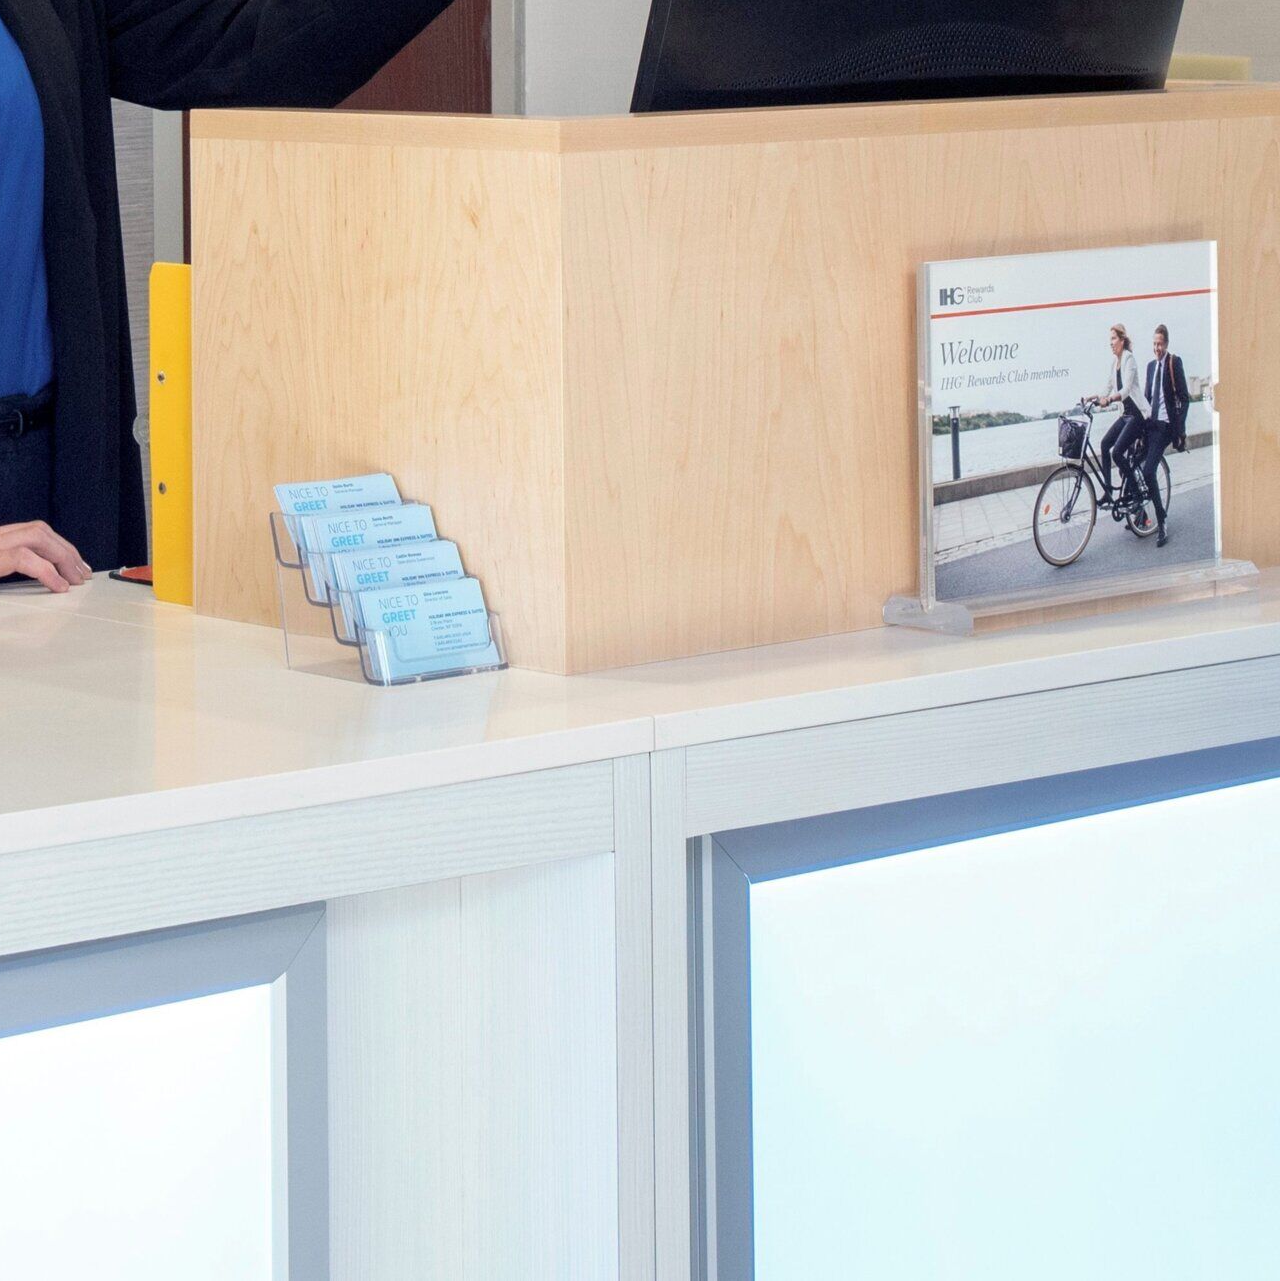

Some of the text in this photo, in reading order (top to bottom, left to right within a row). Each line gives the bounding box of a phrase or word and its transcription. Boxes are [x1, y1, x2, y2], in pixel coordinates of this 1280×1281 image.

[939, 287, 964, 306] IHG
[967, 284, 994, 295] Rewards
[967, 295, 983, 304] Club
[940, 339, 1019, 366] Welcome
[967, 371, 1006, 388] Rewards
[1007, 368, 1029, 384] Club
[1030, 366, 1070, 381] members
[288, 486, 313, 499] NICE
[315, 485, 329, 497] TO
[293, 499, 328, 512] GREET
[328, 521, 351, 534] NICE
[355, 519, 368, 531] TO
[331, 534, 365, 547] GREET
[352, 558, 376, 571] NICE
[379, 556, 392, 568] TO
[356, 571, 390, 585] GREET
[379, 596, 402, 609] NICE
[405, 594, 419, 606] TO
[382, 609, 416, 623] GREET
[386, 625, 408, 637] YOU
